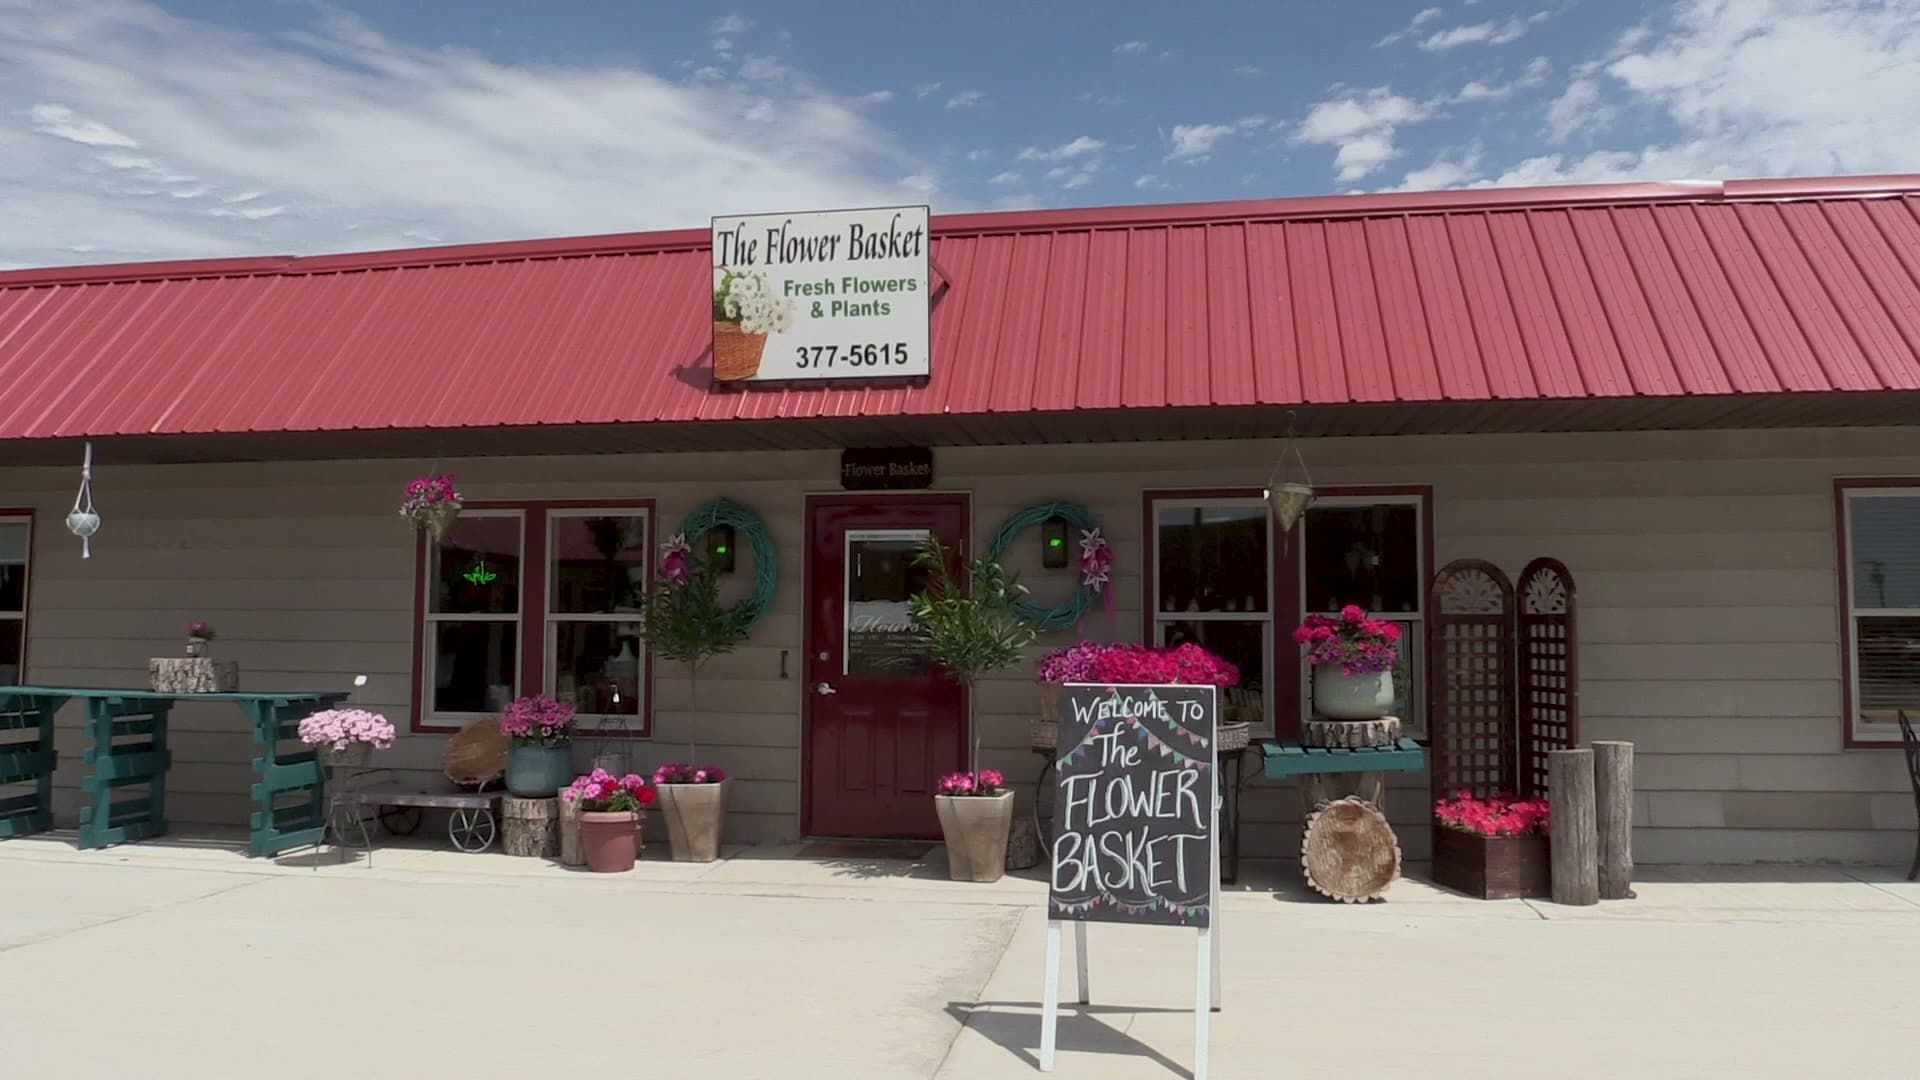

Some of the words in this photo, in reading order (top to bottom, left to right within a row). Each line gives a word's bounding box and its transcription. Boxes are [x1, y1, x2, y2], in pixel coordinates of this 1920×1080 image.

[717, 221, 757, 267] The
[764, 219, 841, 265] Flower
[847, 212, 924, 261] Basket
[783, 278, 835, 297] Fresh
[842, 277, 917, 294] Flowers
[810, 301, 824, 318] &
[831, 299, 891, 317] Plants
[796, 343, 908, 368] 377-5615
[1072, 696, 1168, 724] WELCOME
[1176, 700, 1204, 722] TO
[1093, 721, 1142, 768] The
[1060, 769, 1207, 830] FLOWER
[1052, 825, 1207, 897] BASKET
